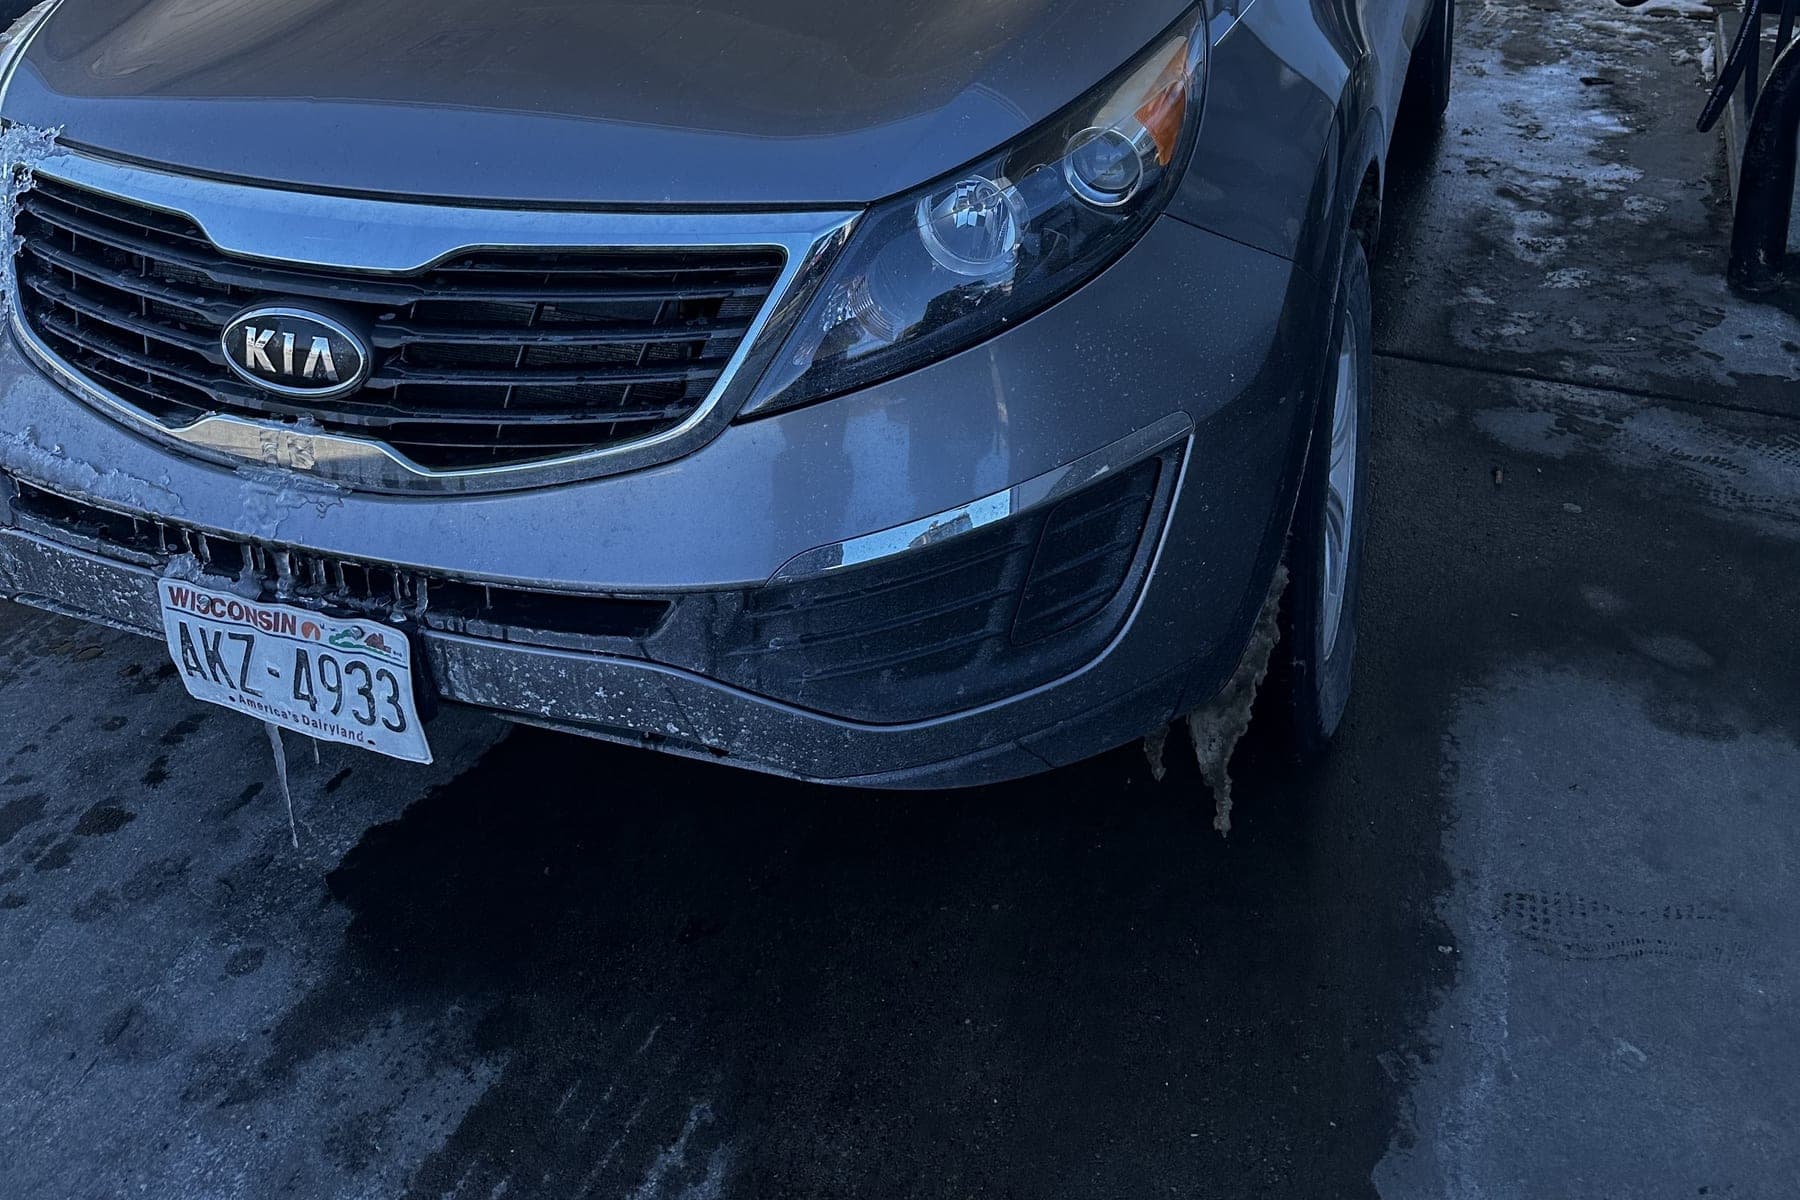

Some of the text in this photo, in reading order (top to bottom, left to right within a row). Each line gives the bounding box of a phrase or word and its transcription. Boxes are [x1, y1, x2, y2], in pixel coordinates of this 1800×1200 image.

[244, 325, 340, 383] KIA
[167, 585, 297, 636] WISCONSIN
[178, 621, 407, 734] AKZ-4933
[239, 693, 365, 743] America's Dairyland
